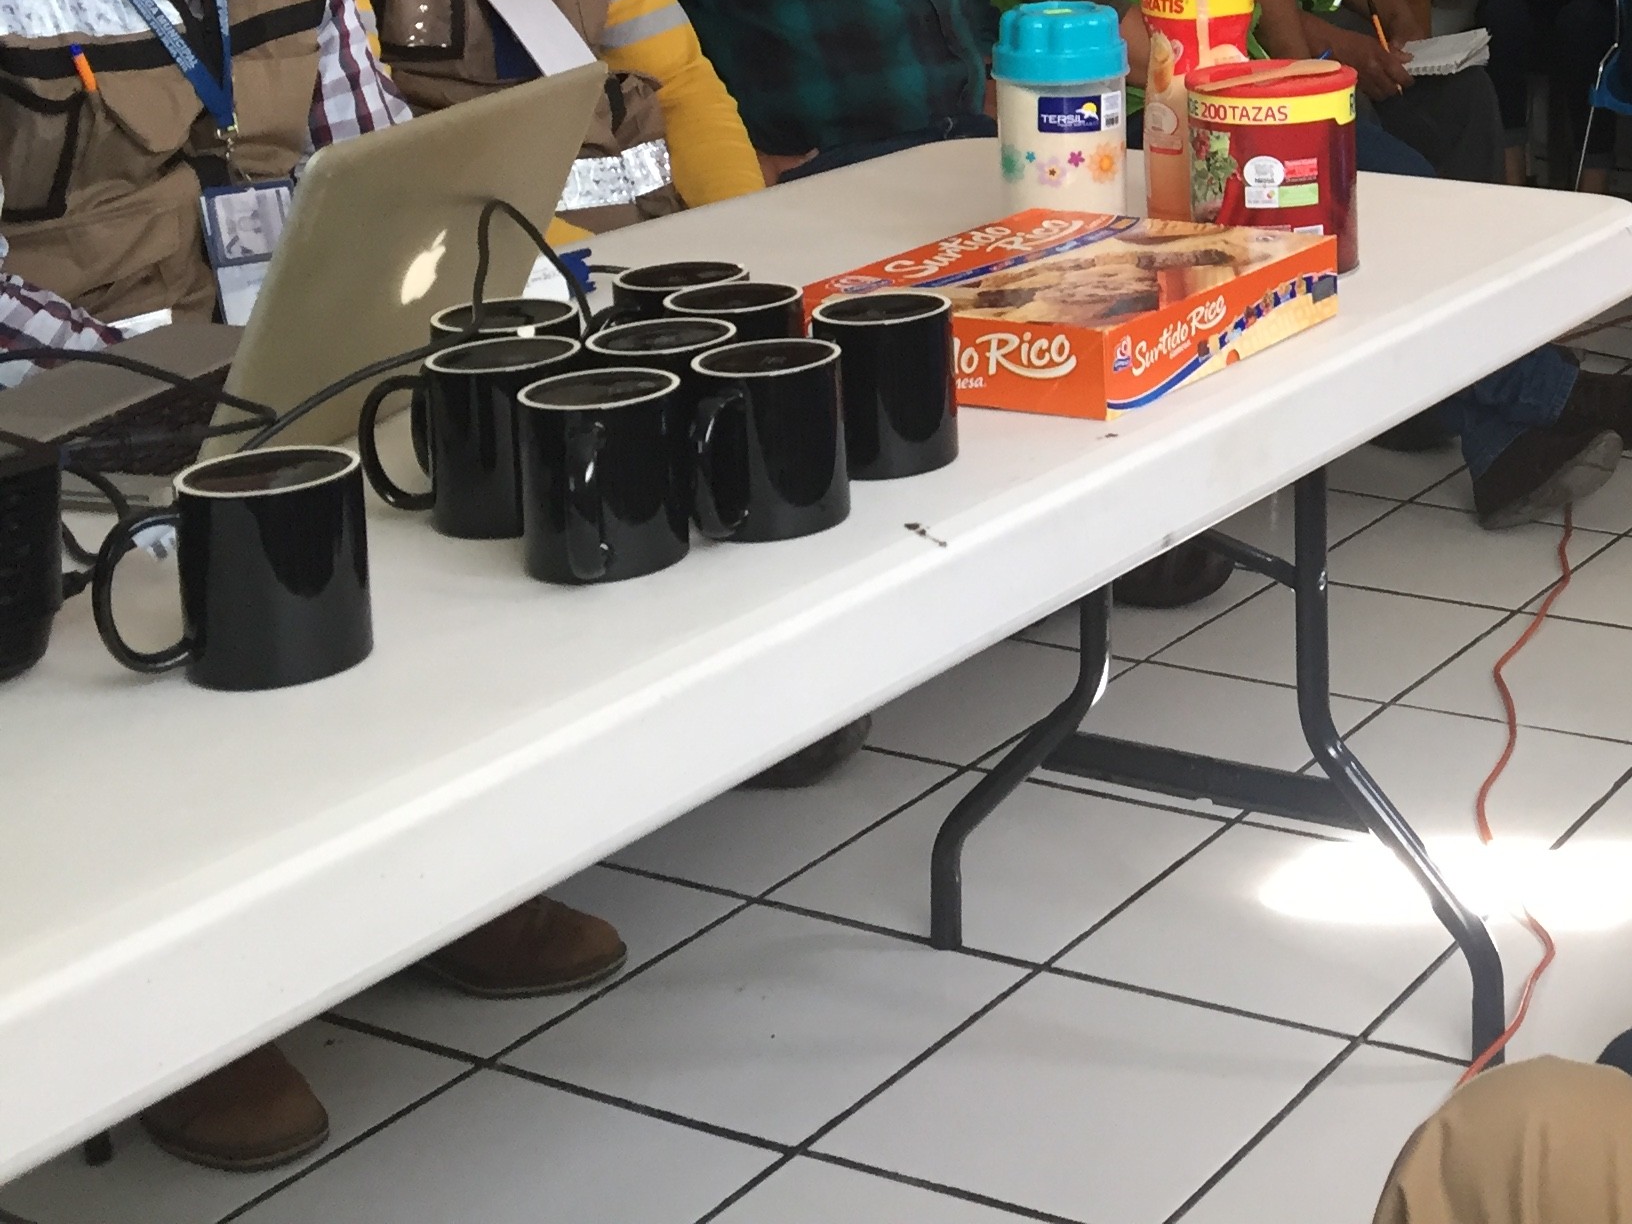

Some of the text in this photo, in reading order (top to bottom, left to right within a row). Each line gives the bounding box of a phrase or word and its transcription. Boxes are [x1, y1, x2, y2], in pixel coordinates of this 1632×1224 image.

[155, 14, 199, 69] MUNICIPAL
[1041, 114, 1085, 124] TERSIL
[1201, 102, 1227, 121] 200
[1228, 105, 1288, 122] TAZAS
[884, 225, 1012, 278] Surtido
[986, 219, 1085, 253] Rico
[975, 331, 1077, 378] Rico
[1132, 322, 1190, 376] Surtido
[1187, 295, 1227, 330] Rico
